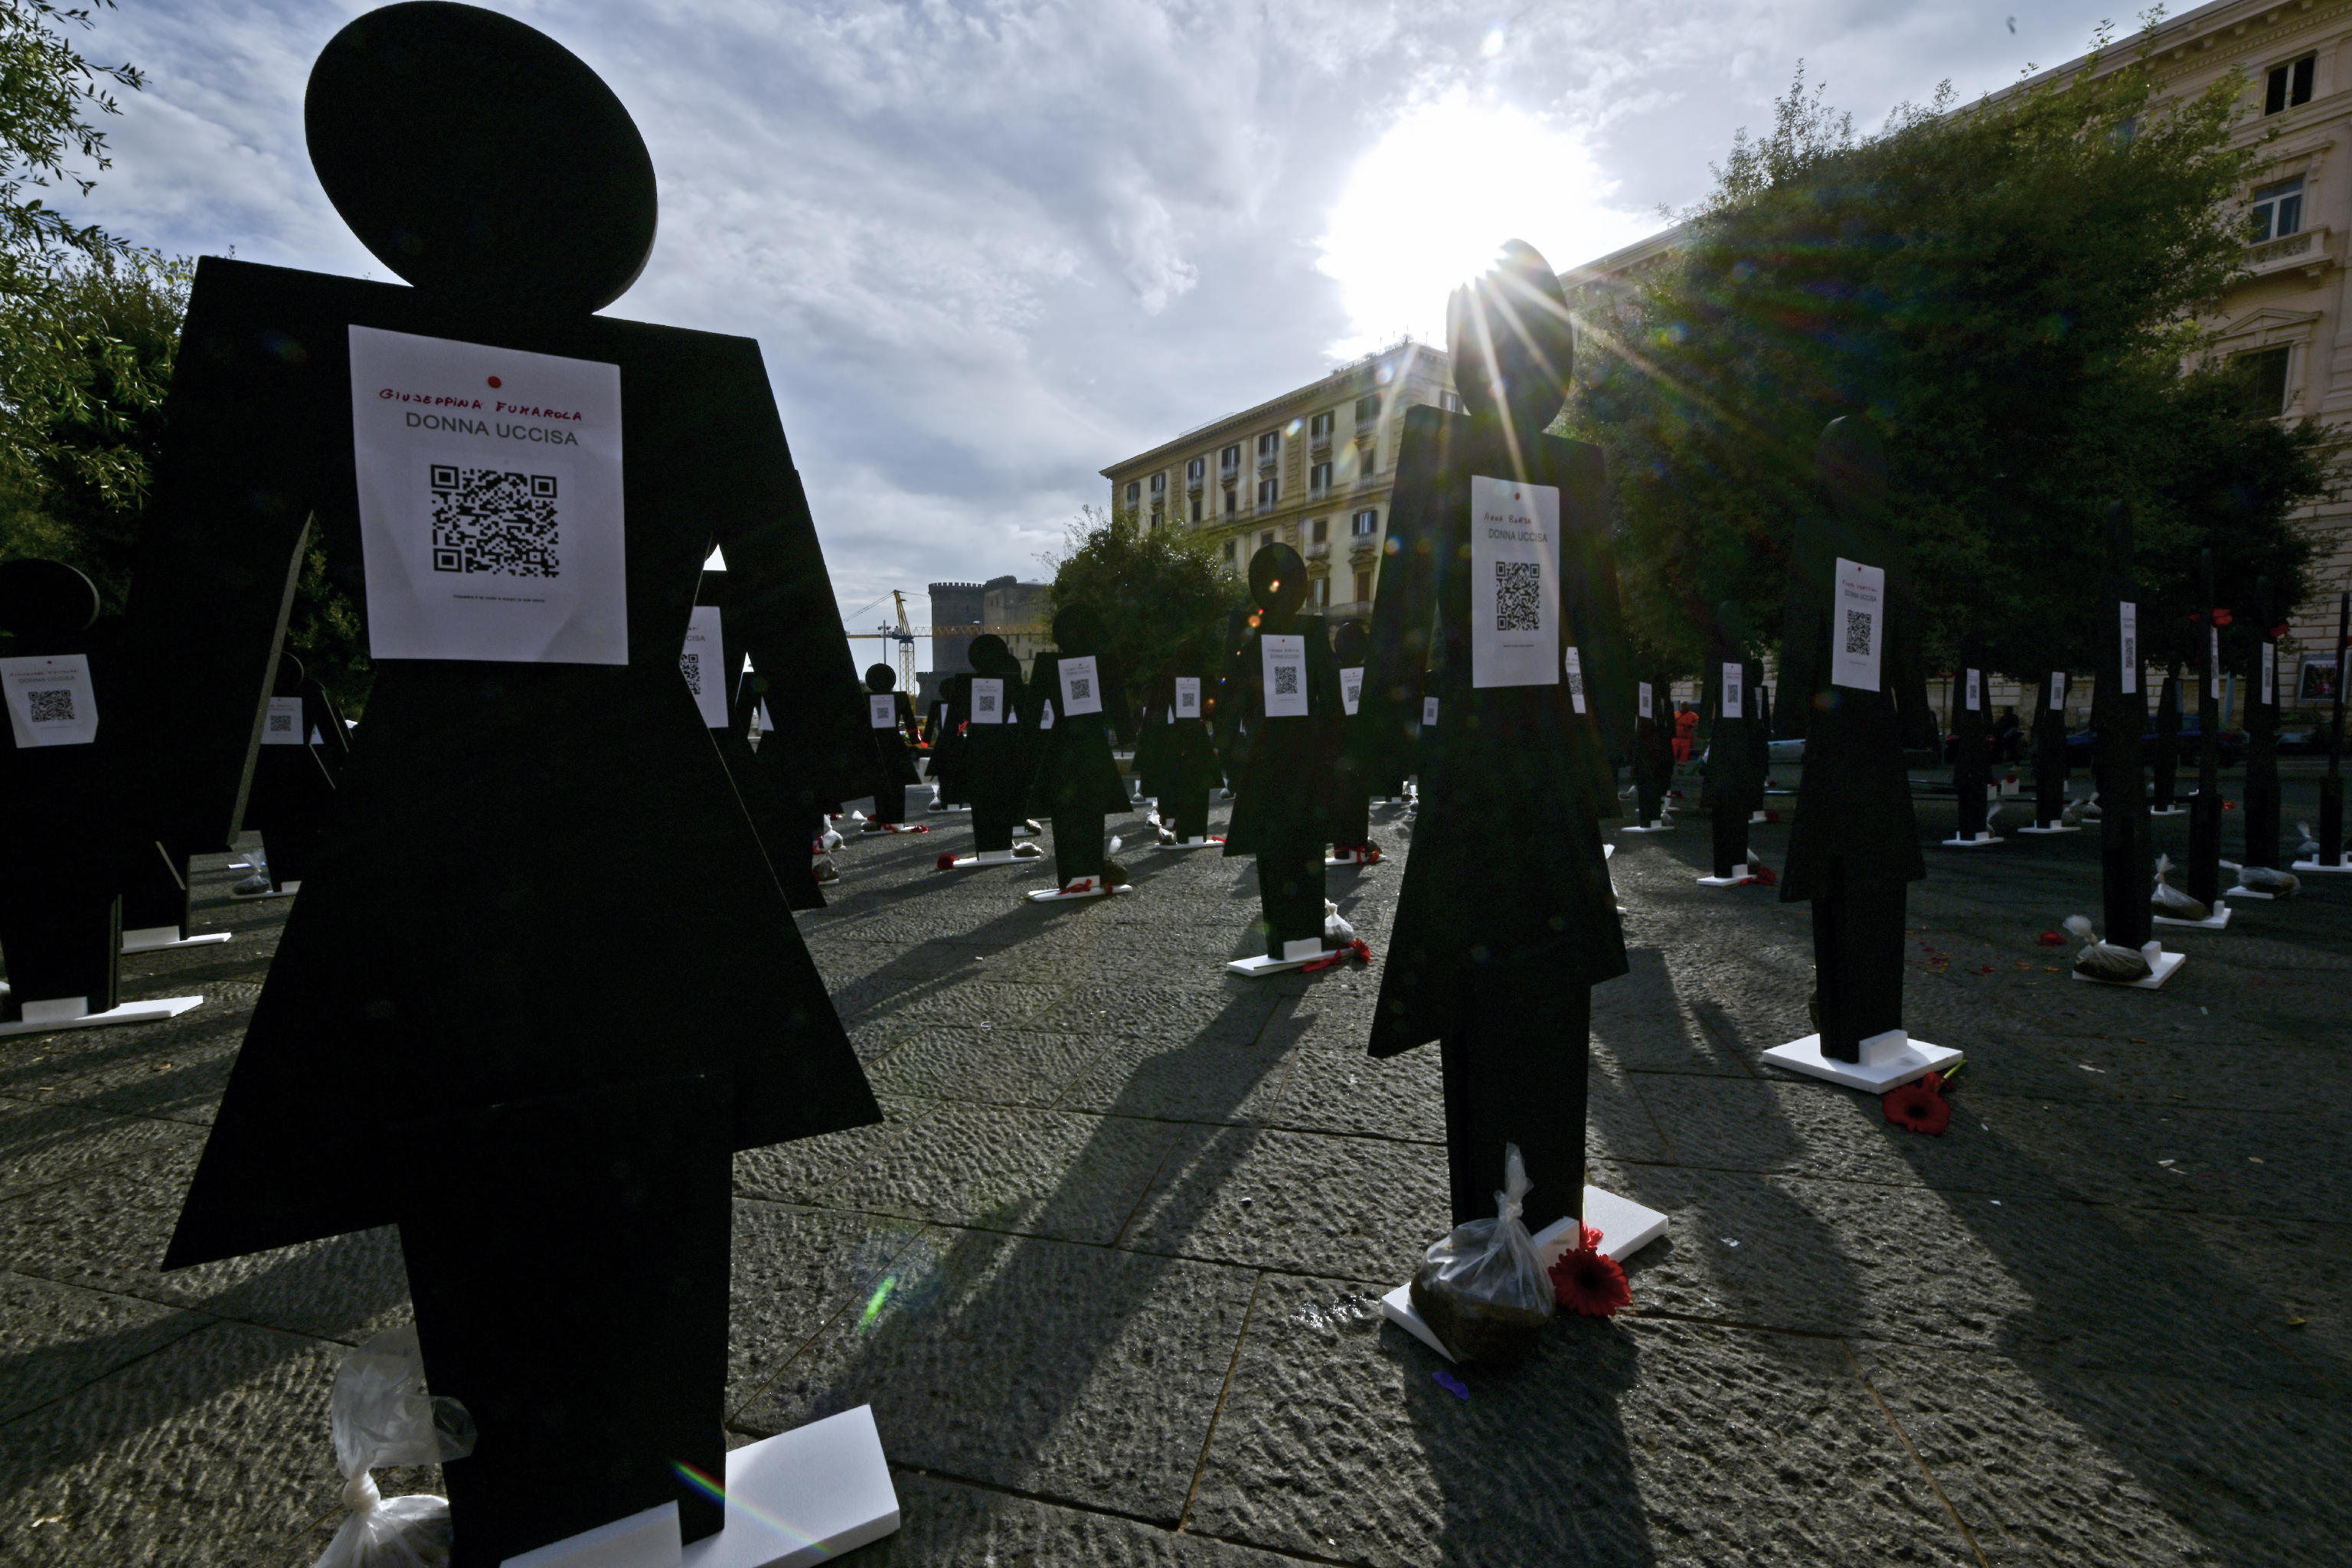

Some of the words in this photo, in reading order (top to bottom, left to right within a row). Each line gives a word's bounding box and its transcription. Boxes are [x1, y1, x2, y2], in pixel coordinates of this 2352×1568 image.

[379, 388, 482, 410] GIUSEPPINA
[406, 412, 489, 436] DONNA
[496, 423, 579, 446] UCCISA
[1488, 528, 1516, 541] DONNA
[1517, 531, 1548, 543] UCCISA
